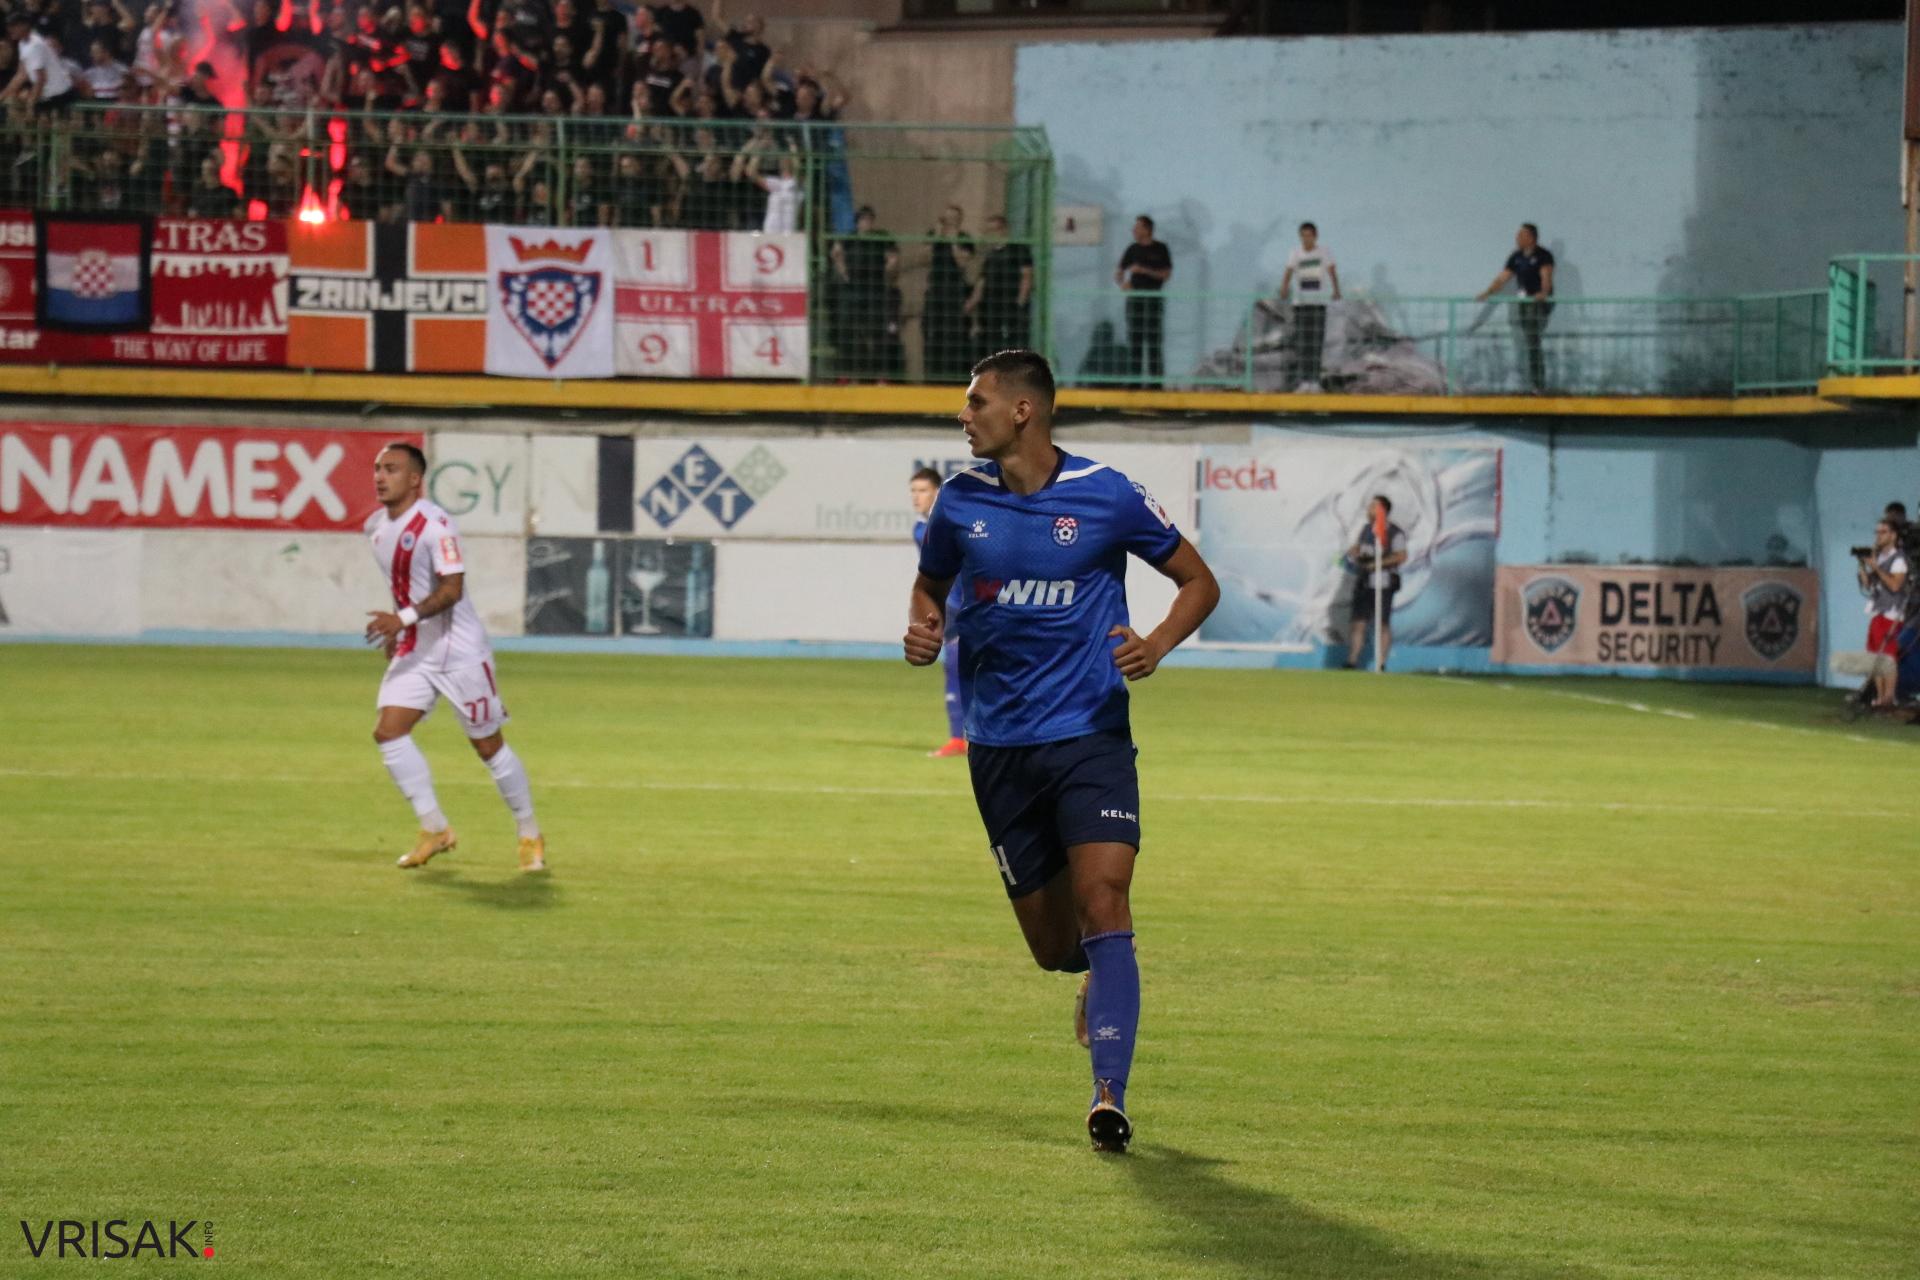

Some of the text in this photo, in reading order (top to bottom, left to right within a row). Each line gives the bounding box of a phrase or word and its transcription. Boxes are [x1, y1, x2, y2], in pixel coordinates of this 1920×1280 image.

[641, 239, 785, 275] 1 9
[297, 278, 486, 312] ZRINJEVCI
[638, 293, 784, 315] ULTRAS
[112, 337, 267, 362] THE WAY OF LIFE
[639, 333, 783, 367] 9 4
[0, 433, 347, 522] NAMEX
[1600, 582, 1723, 626] DELTA
[1597, 631, 1722, 664] SECURITY
[463, 695, 490, 725] 77
[1100, 809, 1137, 823] KELME
